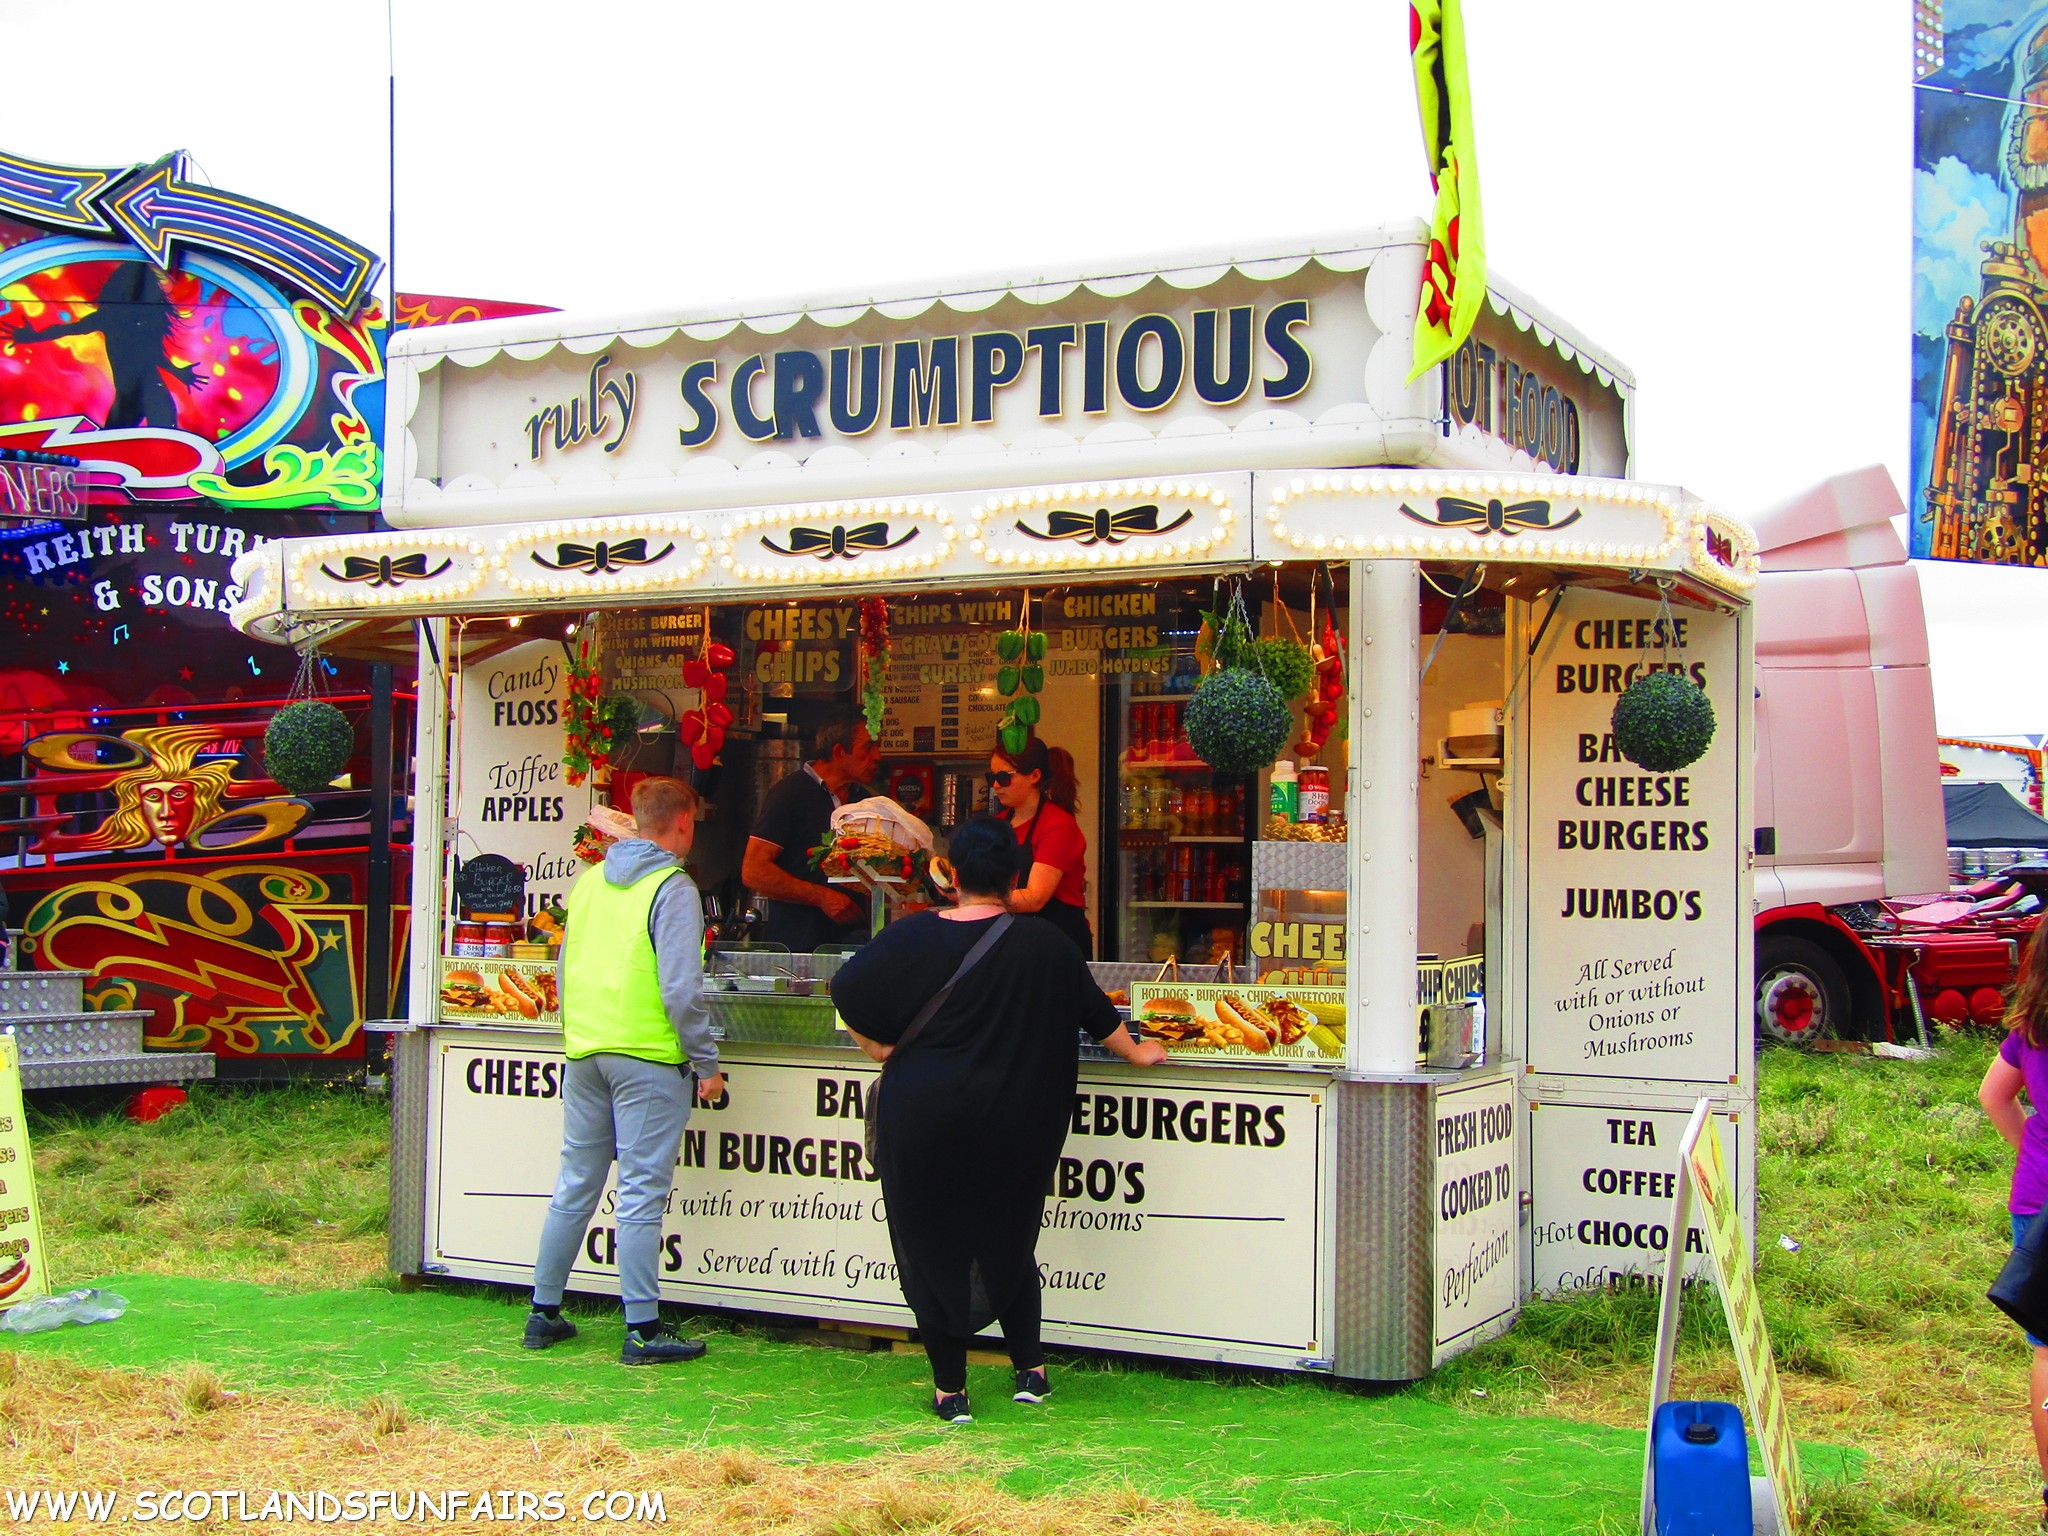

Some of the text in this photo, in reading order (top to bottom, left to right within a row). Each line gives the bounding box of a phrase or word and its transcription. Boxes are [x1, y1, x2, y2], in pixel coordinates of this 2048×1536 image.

[524, 299, 1314, 462] ruly SCRUMPTIOUS
[1440, 333, 1581, 476] OT FOOD
[23, 523, 146, 576] KEITH
[93, 574, 244, 615] & SONS
[1063, 592, 1156, 619] CHICKEN
[650, 613, 703, 630] BURGER
[746, 607, 854, 641] CHEESY
[893, 600, 1012, 625] CHIPS WITH
[633, 636, 648, 648] OR
[651, 634, 700, 648] WITHOUT
[901, 632, 969, 655] GRAVY
[1061, 625, 1159, 651] BURGERS
[1574, 618, 1689, 650] CHEESE
[615, 654, 685, 669] ONIONS OR
[755, 650, 841, 684] CHIPS
[918, 663, 985, 684] CURRY
[1049, 659, 1097, 676] JUMBO
[1102, 657, 1170, 674] HOTDOGS
[488, 655, 558, 700] Candy
[494, 699, 558, 727] FLOSS
[890, 696, 920, 704] SAUSAGE
[968, 704, 1007, 713] CHOCOLATE
[890, 729, 904, 737] DOG
[488, 753, 559, 797] Toffee
[1575, 777, 1690, 807] CHEESE
[482, 796, 564, 823] APPLES
[1557, 819, 1710, 852] BURGERS
[1561, 887, 1703, 921] JUMBO'S
[1250, 920, 1346, 961] CHEE
[444, 960, 459, 972] HOT
[460, 961, 480, 973] DOGS
[484, 963, 517, 974] BURGERS
[1575, 948, 1677, 986] All Served
[1141, 988, 1345, 1005] HOT DOGS BURGERS CHIPS SWEETCORN
[1554, 975, 1707, 1013] with or without
[504, 1011, 525, 1021] CHIPS
[1588, 1004, 1682, 1032] Onions or
[1223, 1043, 1251, 1056] CHIPS
[1272, 1045, 1305, 1058] CURRY
[1583, 1030, 1694, 1060] Mushrooms
[465, 1058, 565, 1099] CHEES
[1437, 1102, 1512, 1158] FRESH FOOD
[1606, 1118, 1657, 1146] TEA
[1441, 1162, 1511, 1222] COOKED TO
[1582, 1167, 1677, 1199] COFFEE
[680, 1189, 733, 1217] with
[740, 1197, 766, 1218] or
[769, 1189, 864, 1222] without
[1533, 1221, 1576, 1248] Hot
[697, 1247, 779, 1276] Served
[780, 1248, 836, 1278] with
[1442, 1229, 1510, 1310] Perfection
[1558, 1265, 1609, 1292] Cold
